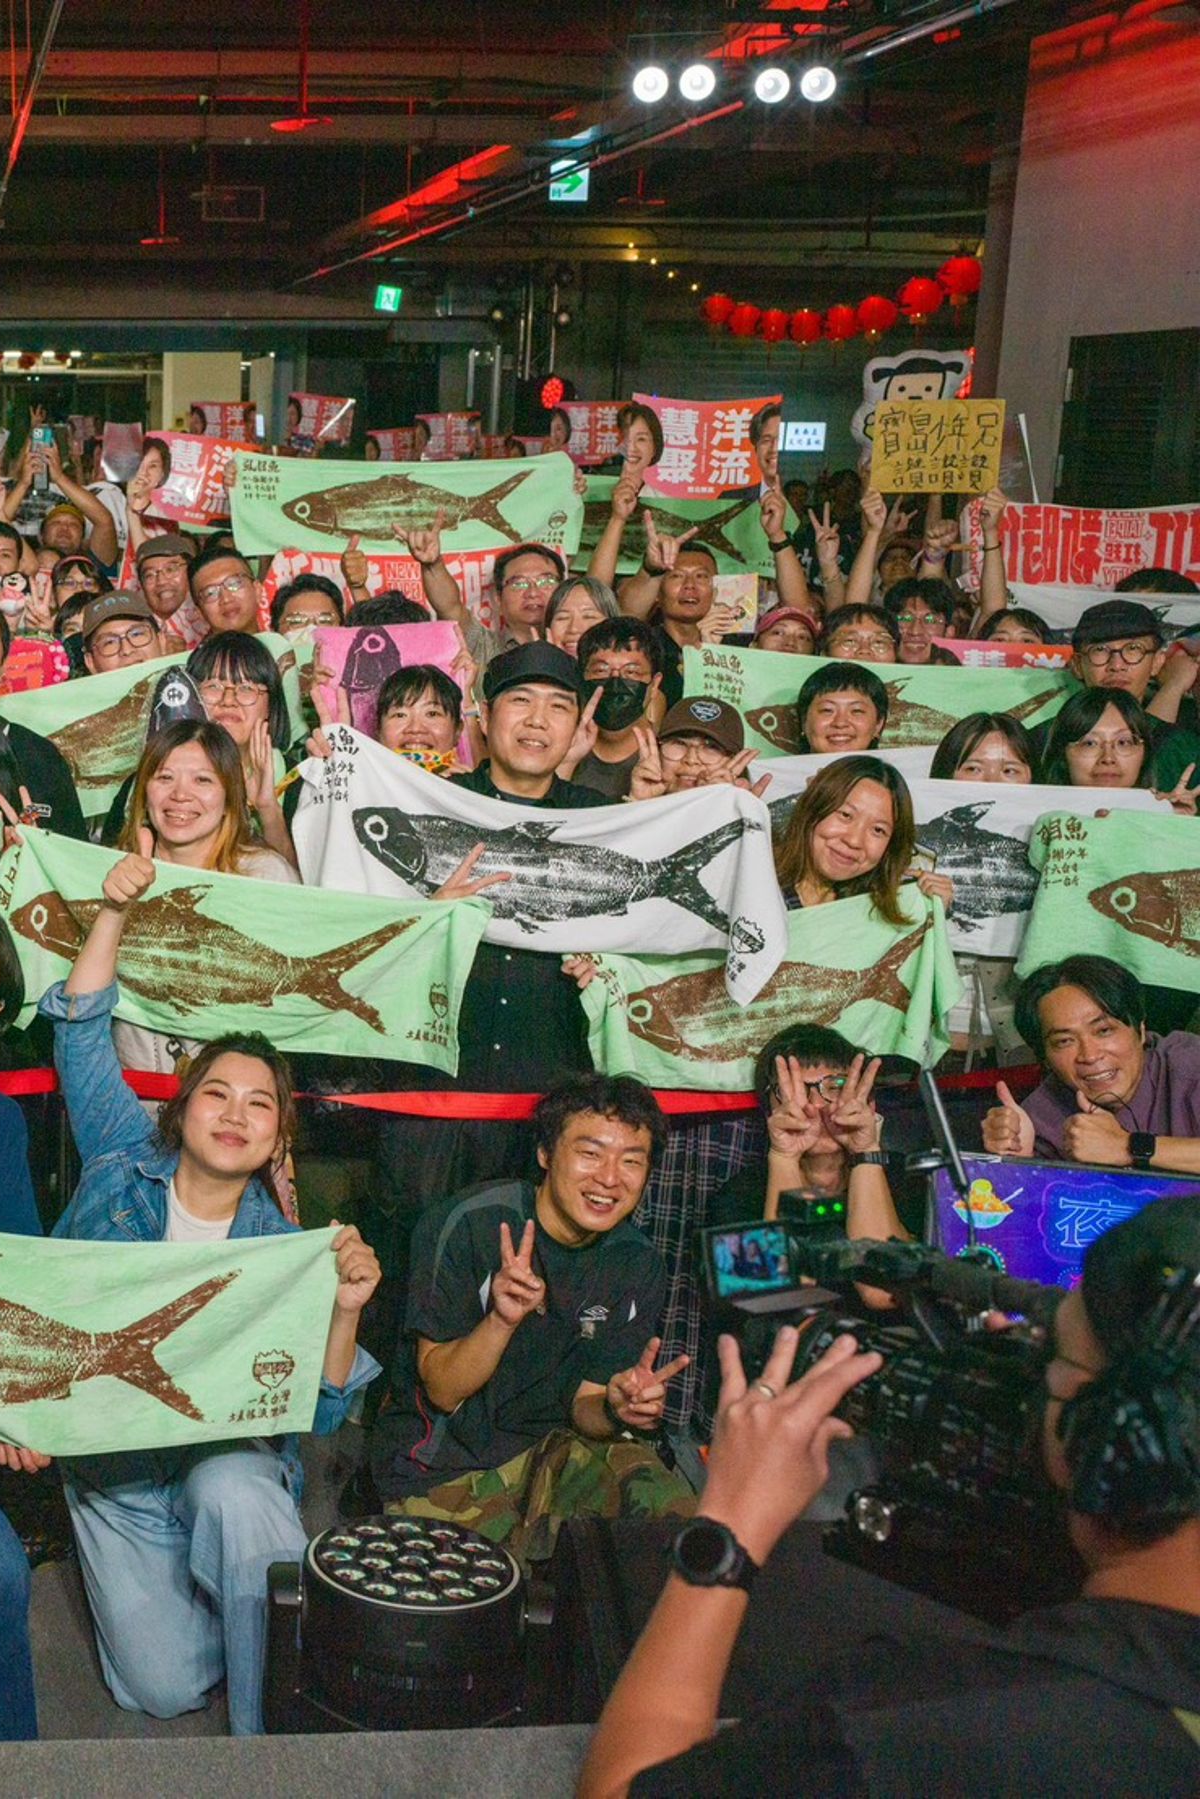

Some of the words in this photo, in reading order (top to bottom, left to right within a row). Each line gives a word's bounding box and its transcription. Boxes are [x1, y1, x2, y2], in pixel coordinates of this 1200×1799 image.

[879, 406, 998, 459] 寶島少年兄
[385, 561, 422, 580] NEW
[1043, 876, 1079, 889] 十一台斤
